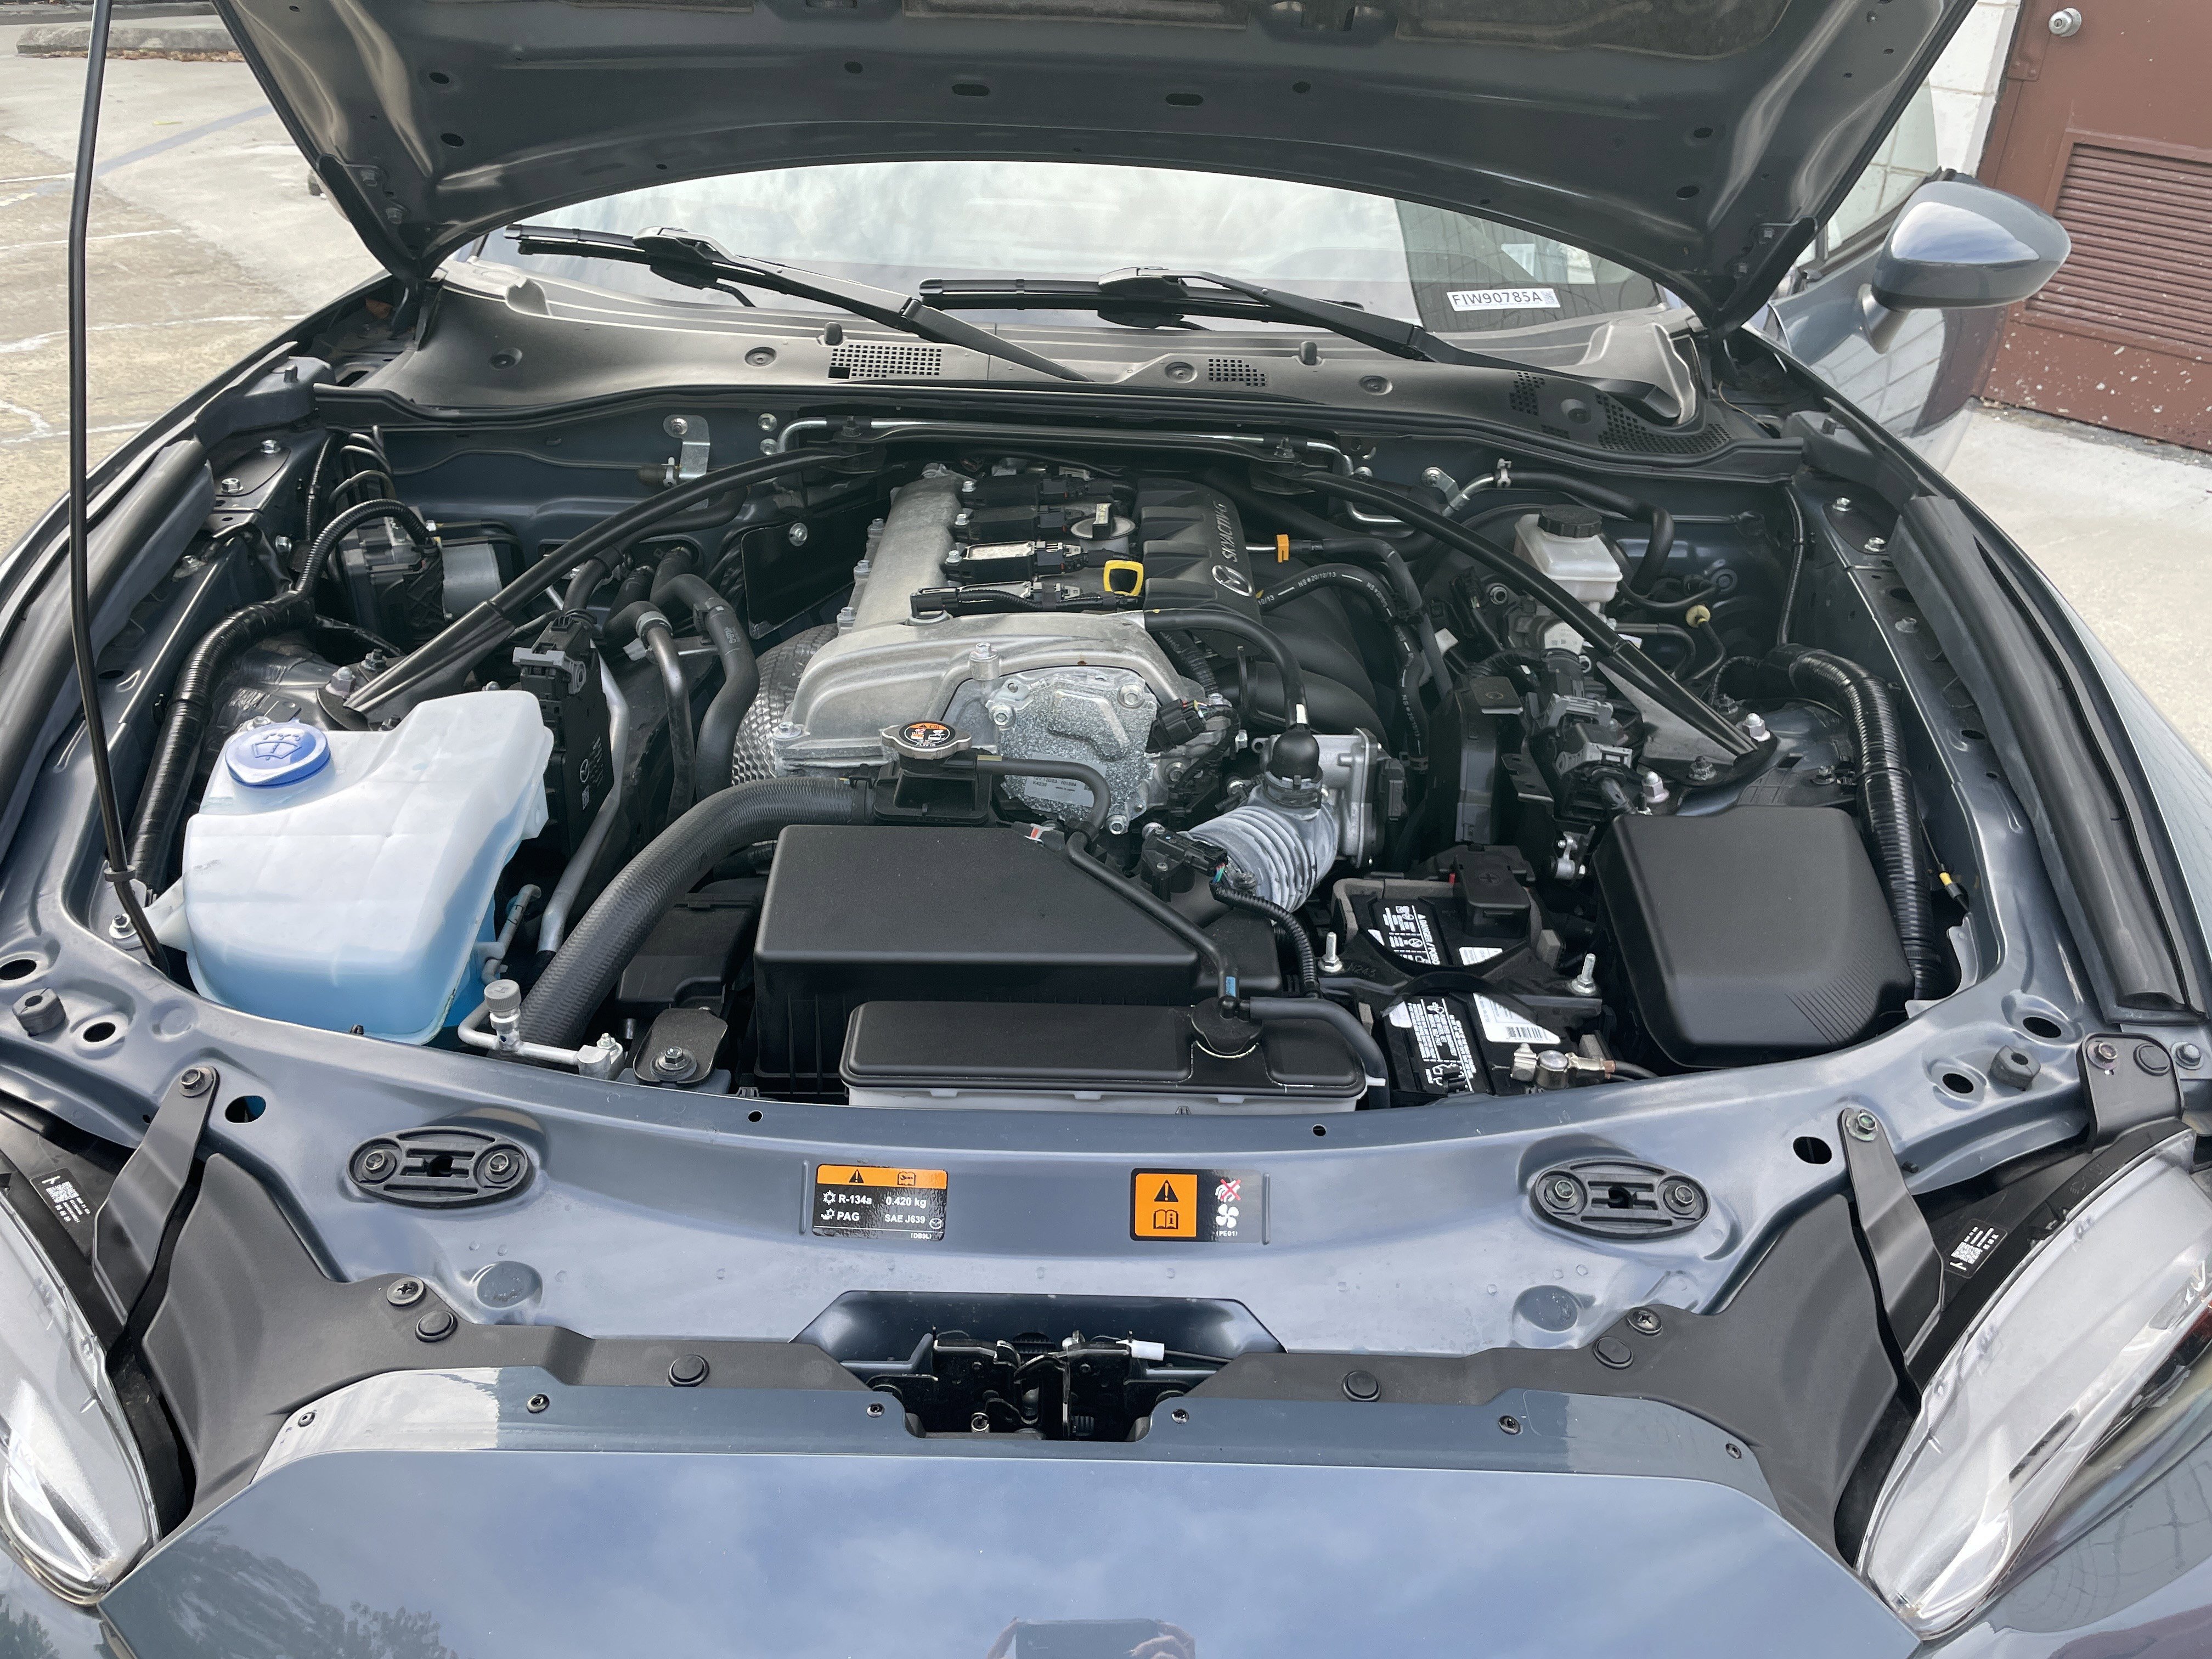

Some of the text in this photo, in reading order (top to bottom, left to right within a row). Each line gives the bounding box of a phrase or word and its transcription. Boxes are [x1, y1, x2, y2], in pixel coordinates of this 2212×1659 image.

[1452, 291, 1543, 305] FIW90785A
[1212, 500, 1238, 563] SKYACTIV-G
[1419, 919, 1433, 943] DANGER
[1427, 947, 1441, 965] POISO
[838, 1194, 927, 1209] R-134a 0.420 kg
[837, 1211, 926, 1224] PAG SAE J639
